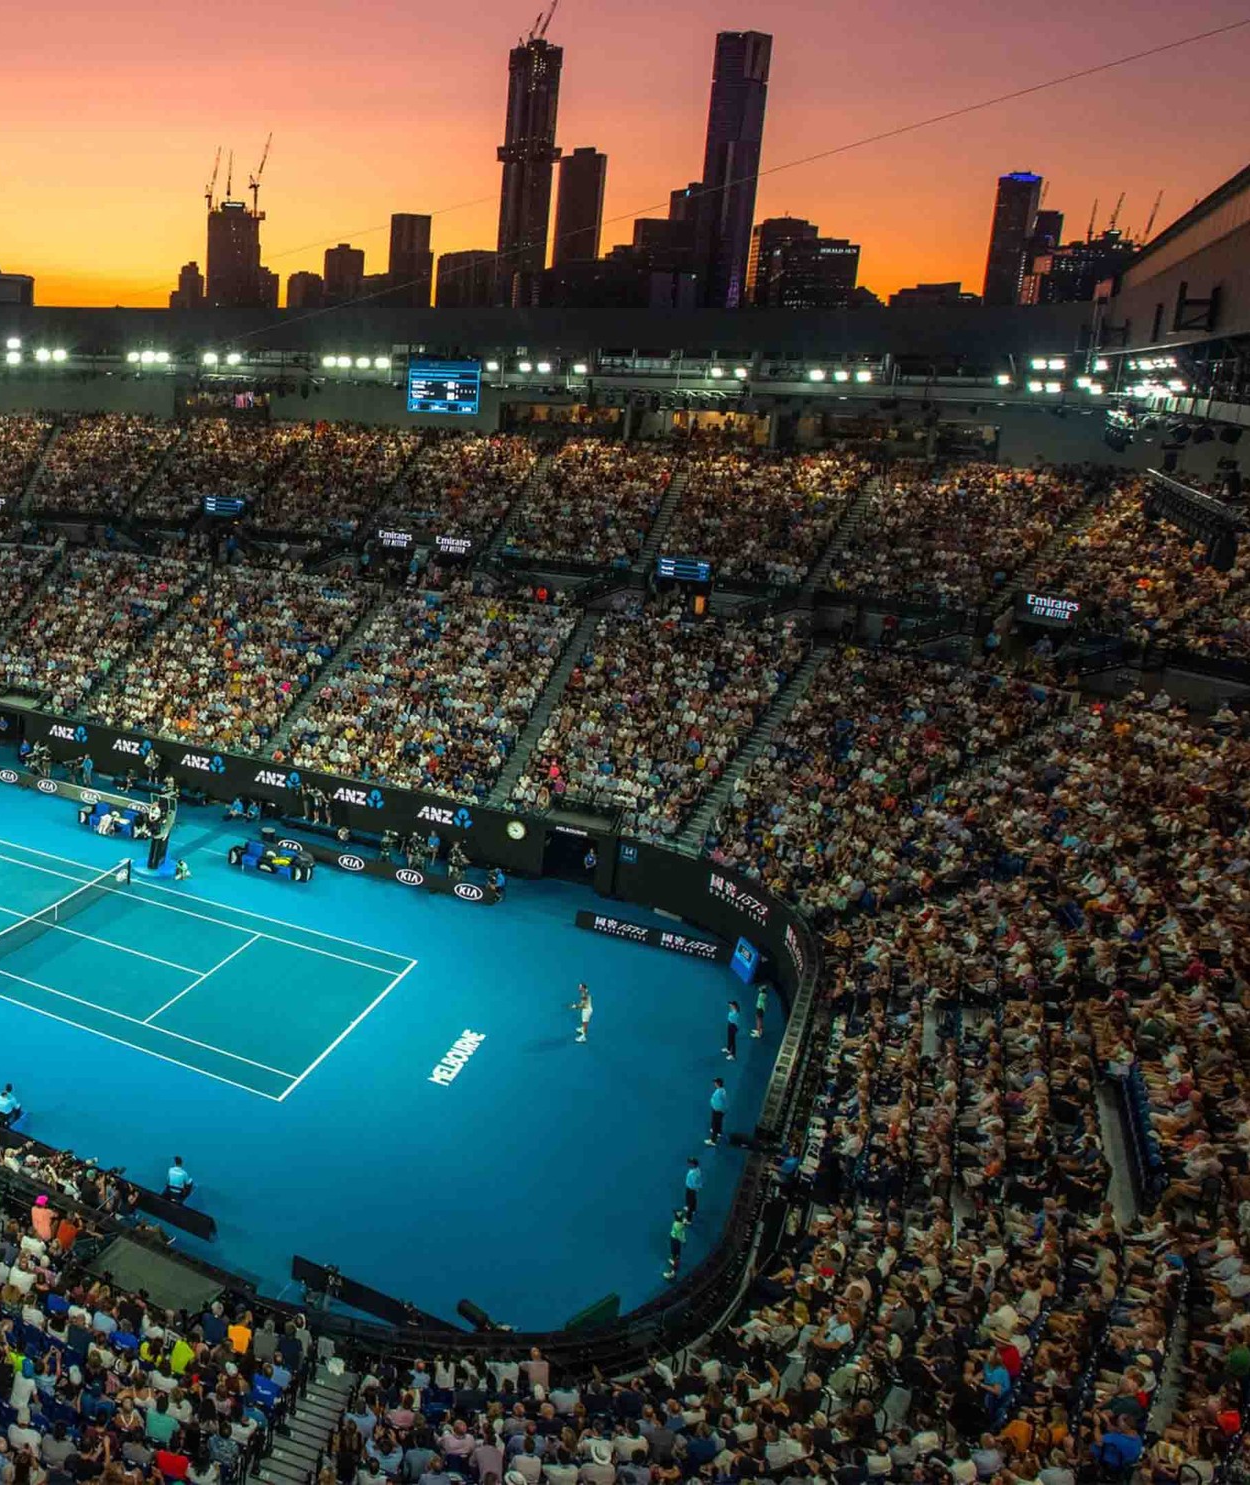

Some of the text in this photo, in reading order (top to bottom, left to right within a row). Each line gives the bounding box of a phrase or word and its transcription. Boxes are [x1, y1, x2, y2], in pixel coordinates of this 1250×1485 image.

[378, 529, 412, 541] Emirates
[435, 535, 471, 548] Emirates
[1026, 593, 1080, 612] Emirates
[1032, 606, 1070, 619] FLY BETTER
[49, 724, 75, 740] ANZ
[112, 738, 140, 755] ANZ
[181, 753, 210, 771] ANZ
[254, 770, 286, 787] ANZ
[333, 787, 367, 806] ANZ
[417, 805, 454, 825] ANZ
[342, 857, 360, 868] KIA
[400, 871, 419, 883] KIA
[458, 886, 478, 898] KIA
[737, 893, 768, 914] 1573
[617, 924, 648, 935] 1573
[686, 941, 717, 952] 1573
[428, 1028, 486, 1086] MELBOURNE
